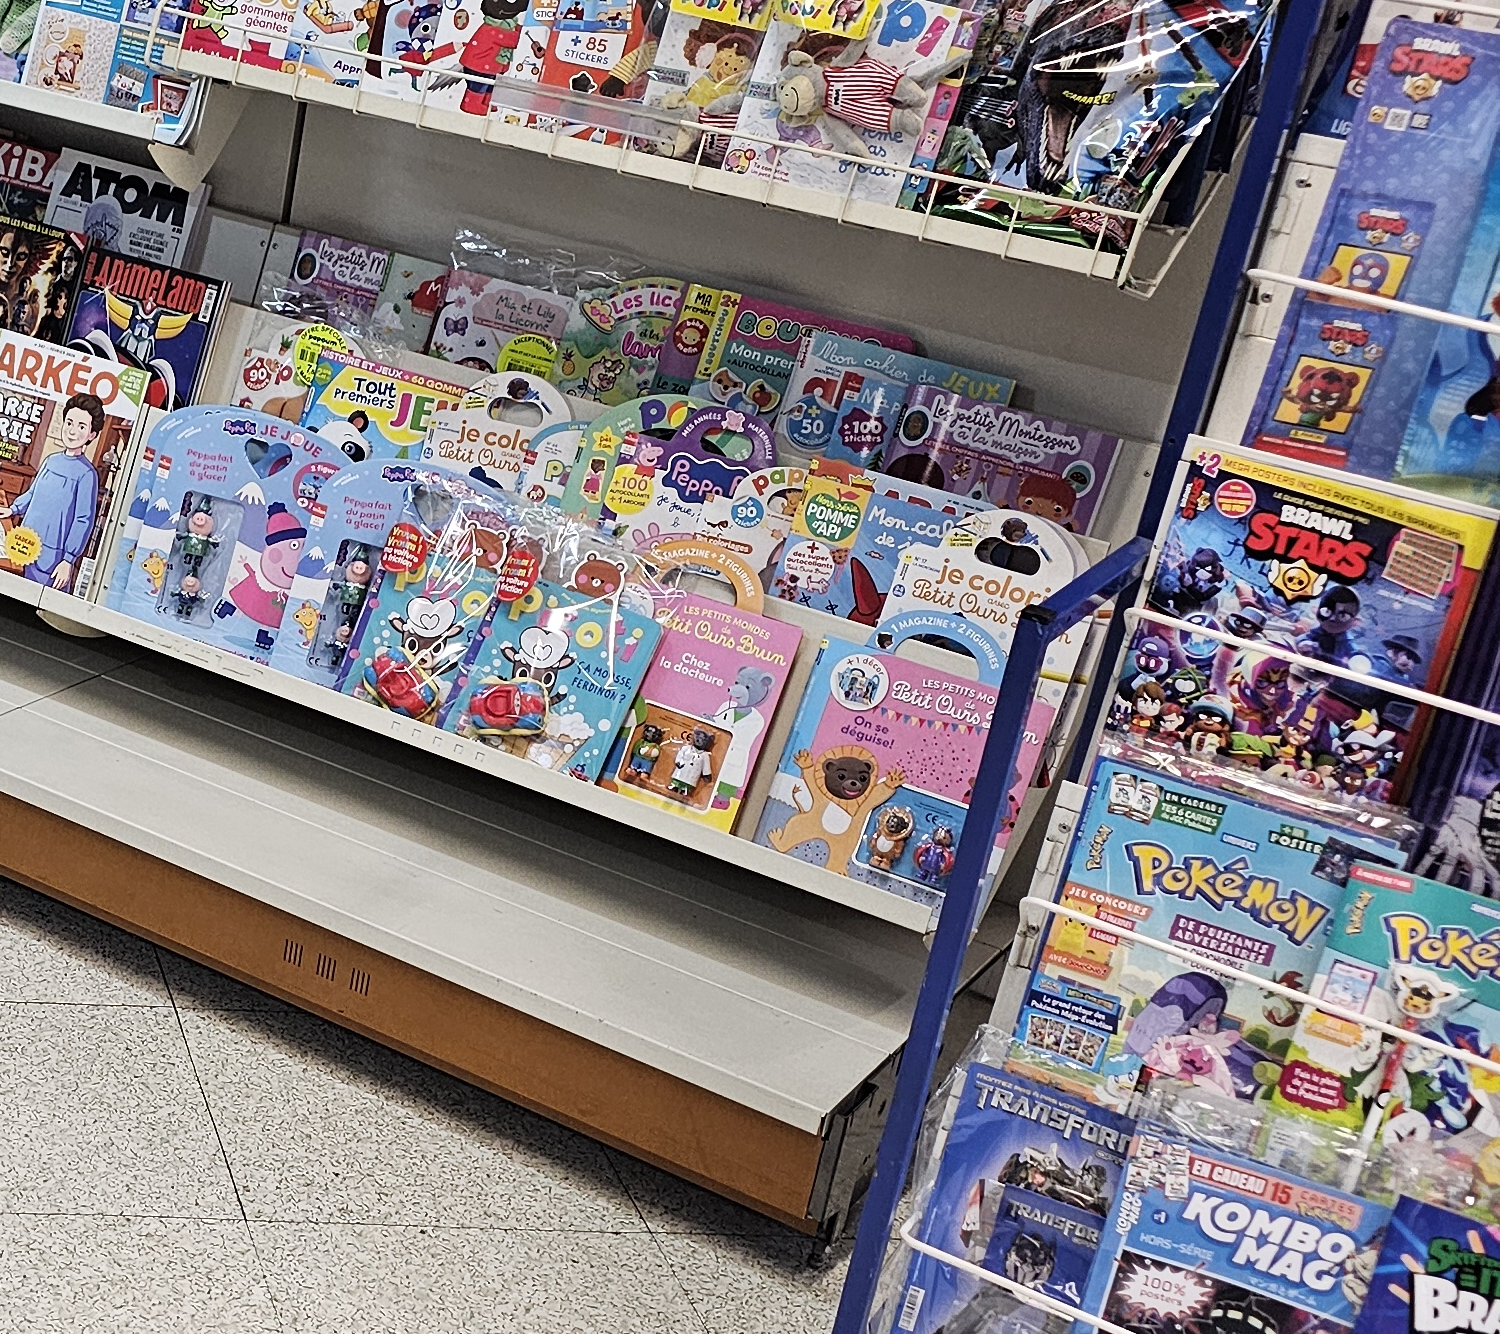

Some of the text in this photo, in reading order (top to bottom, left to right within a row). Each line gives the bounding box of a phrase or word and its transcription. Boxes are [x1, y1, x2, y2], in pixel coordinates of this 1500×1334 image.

[245, 14, 289, 35] géantes
[564, 47, 610, 66] STICKERS
[59, 161, 191, 227] ATOM
[496, 295, 519, 311] Mia
[507, 311, 550, 332] Licorne
[943, 372, 1001, 404] JEUX
[996, 413, 1080, 455] Montessori
[203, 462, 229, 475] patin
[439, 440, 521, 473] Petit Ours
[1250, 465, 1330, 496] POSTERS INCLUS
[806, 502, 859, 528] POMME
[1279, 504, 1354, 541] BRAWL
[1245, 512, 1375, 580] STARS
[732, 618, 770, 642] MONDES
[737, 639, 787, 668] Brun
[674, 658, 725, 688] docteure
[840, 721, 895, 751] déguise!
[1188, 809, 1218, 830] CARTES
[1269, 831, 1323, 855] POSTER
[1068, 885, 1149, 917] JEU CONCOURS
[1175, 928, 1267, 966] ADVERSAIRES
[1195, 922, 1270, 956] PUISSANTS
[1214, 1165, 1292, 1207] CADEAU 15
[1183, 1192, 1358, 1264] KOMBO
[1138, 1232, 1214, 1262] HORS-SÉRIE
[1232, 1237, 1340, 1292] MAG
[1141, 1274, 1188, 1297] 100%
